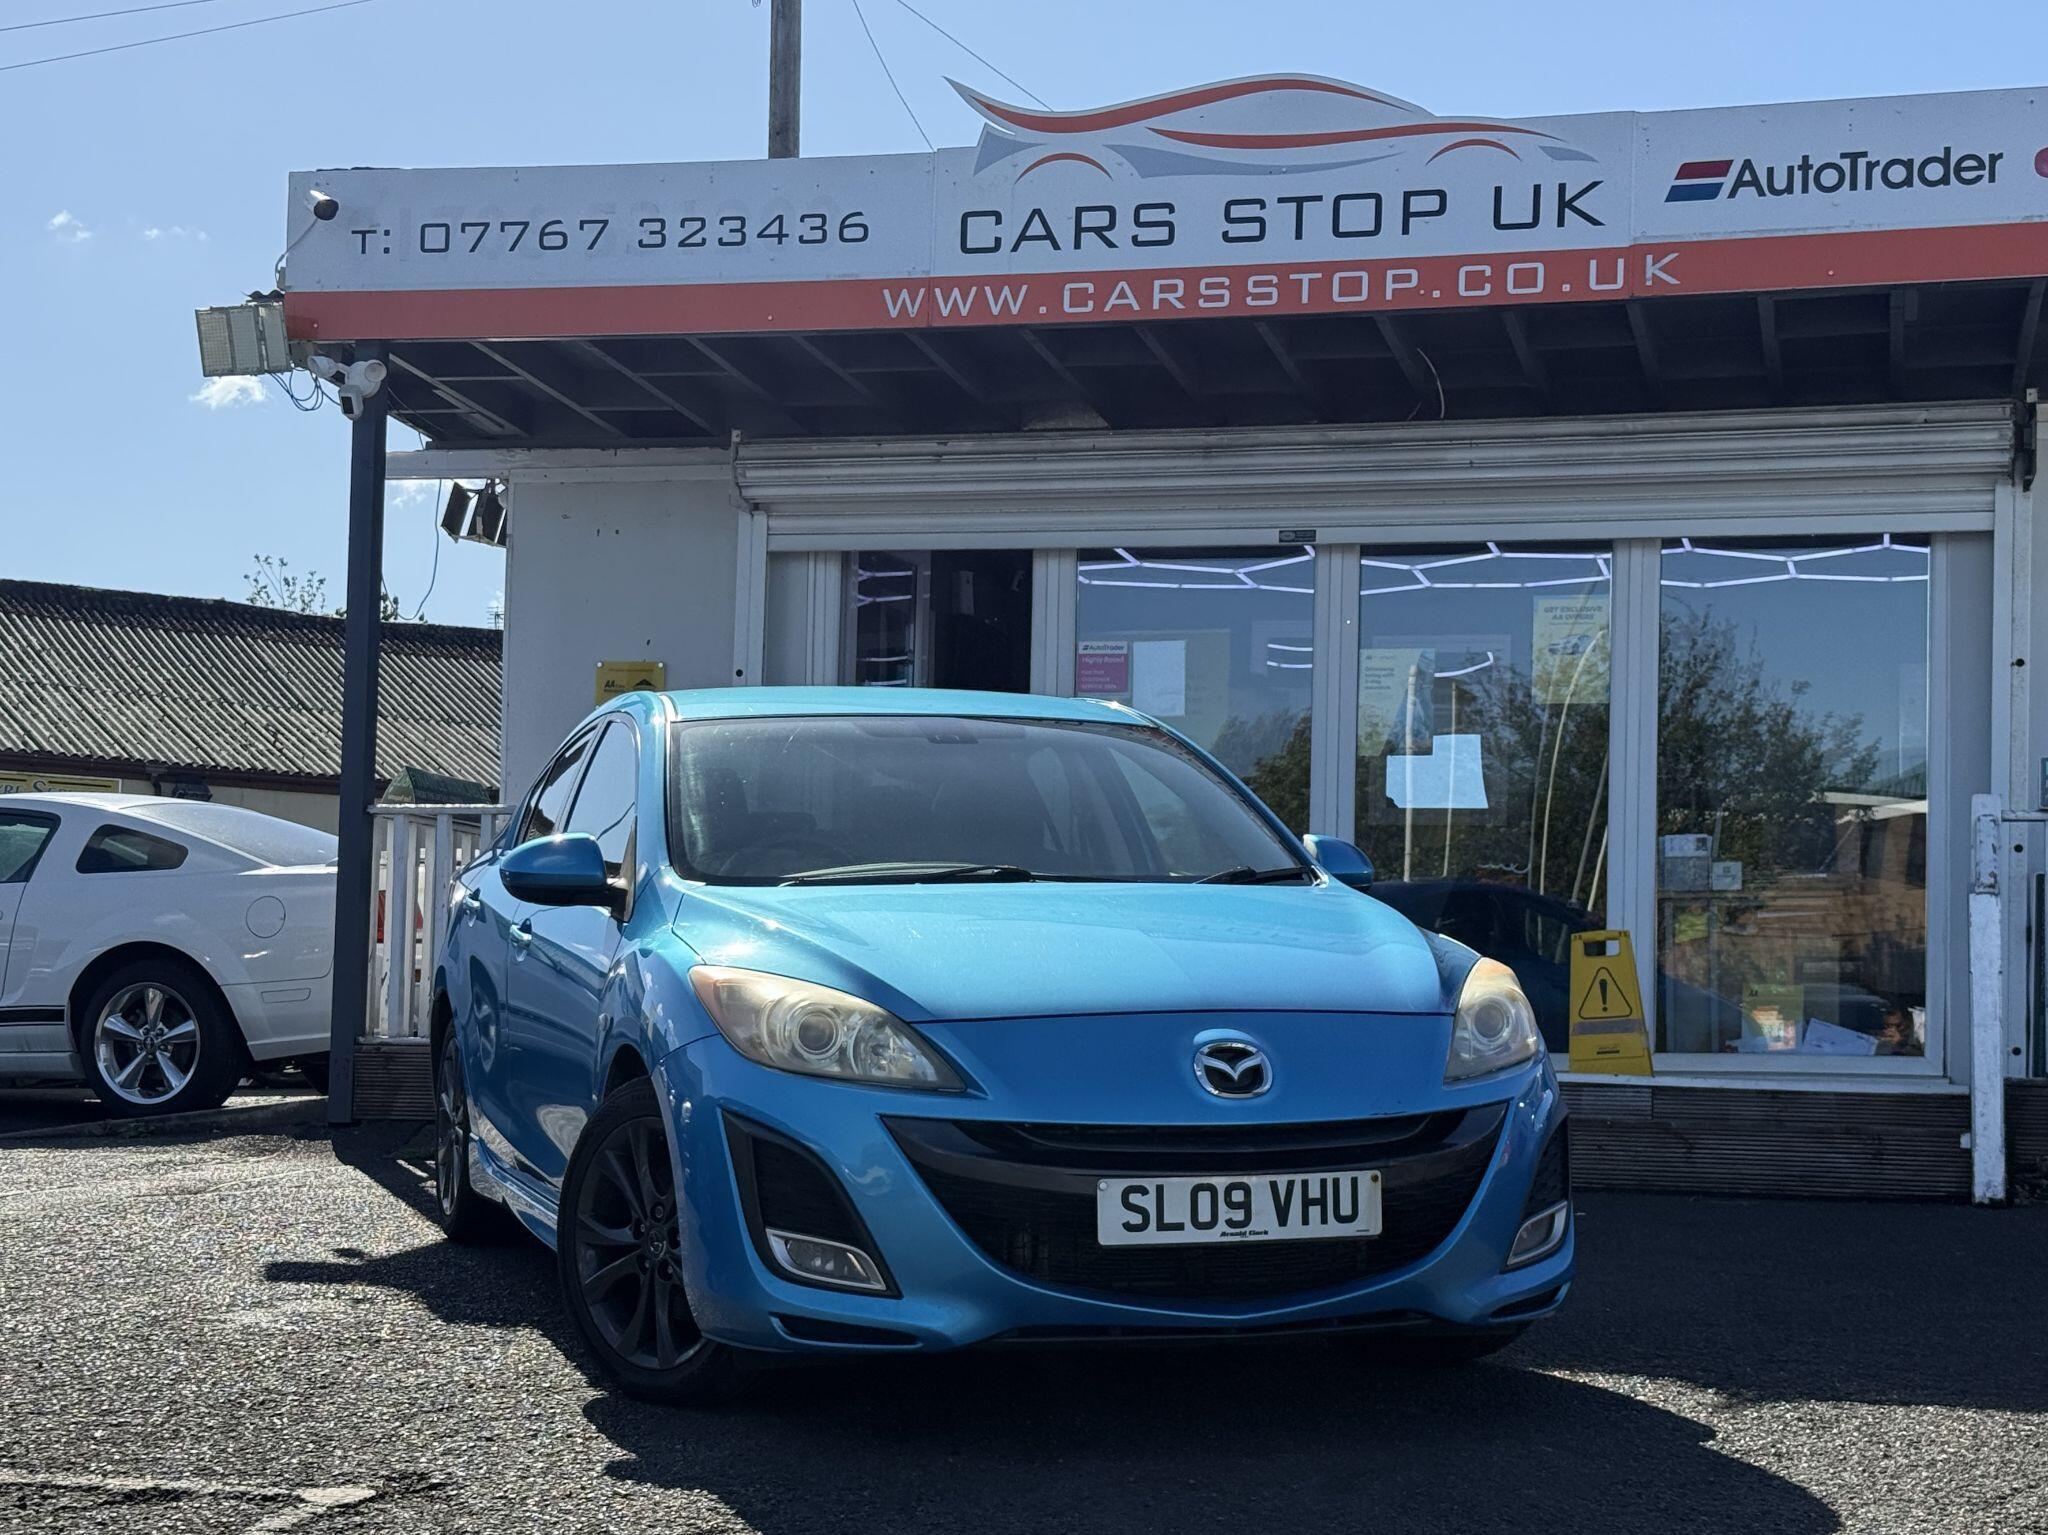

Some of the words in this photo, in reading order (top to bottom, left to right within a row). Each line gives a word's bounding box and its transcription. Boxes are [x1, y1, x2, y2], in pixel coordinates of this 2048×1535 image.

[1727, 146, 2004, 199] AutoTrader
[350, 229, 391, 255] T:
[419, 219, 610, 254] 07767
[637, 211, 871, 250] 323436
[959, 202, 1176, 254] CARS
[1221, 188, 1448, 244] STOP
[1492, 180, 1605, 231] UK
[883, 252, 1681, 319] WWW.CARSSTOP.CO.UK
[1120, 1181, 1253, 1233] SL09
[1268, 1176, 1360, 1228] VHU
